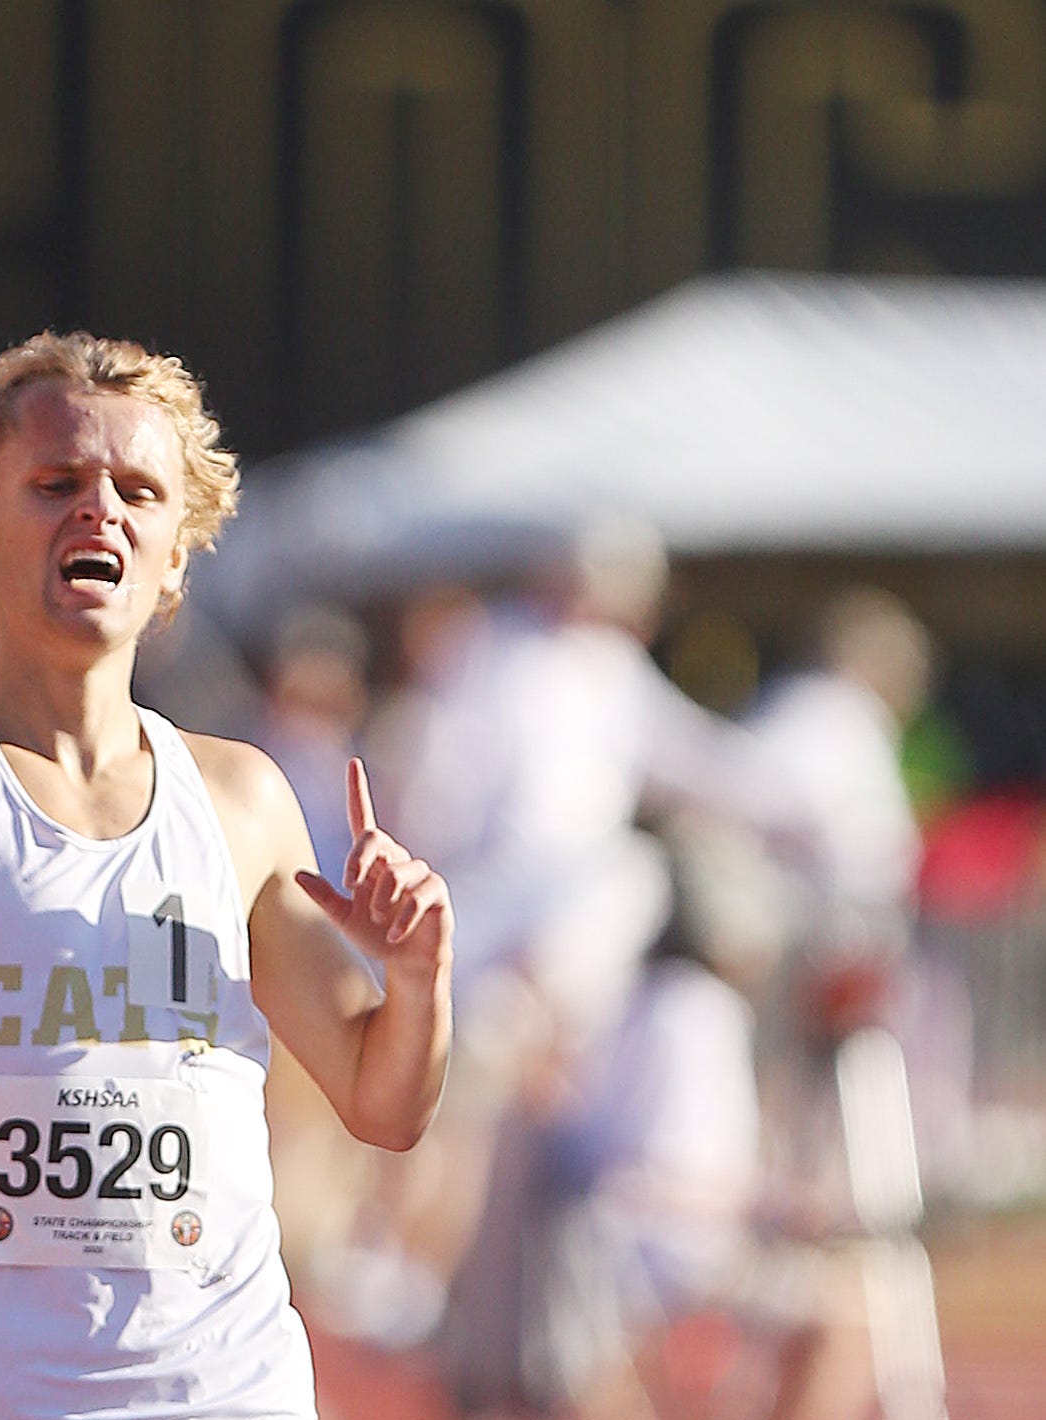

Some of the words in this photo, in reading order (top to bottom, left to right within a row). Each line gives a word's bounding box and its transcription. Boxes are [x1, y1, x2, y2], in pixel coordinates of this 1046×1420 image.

[154, 894, 186, 1003] 1
[58, 1088, 140, 1107] KSHSAA
[34, 1216, 65, 1227] STATE
[53, 1229, 90, 1240] TRACK
